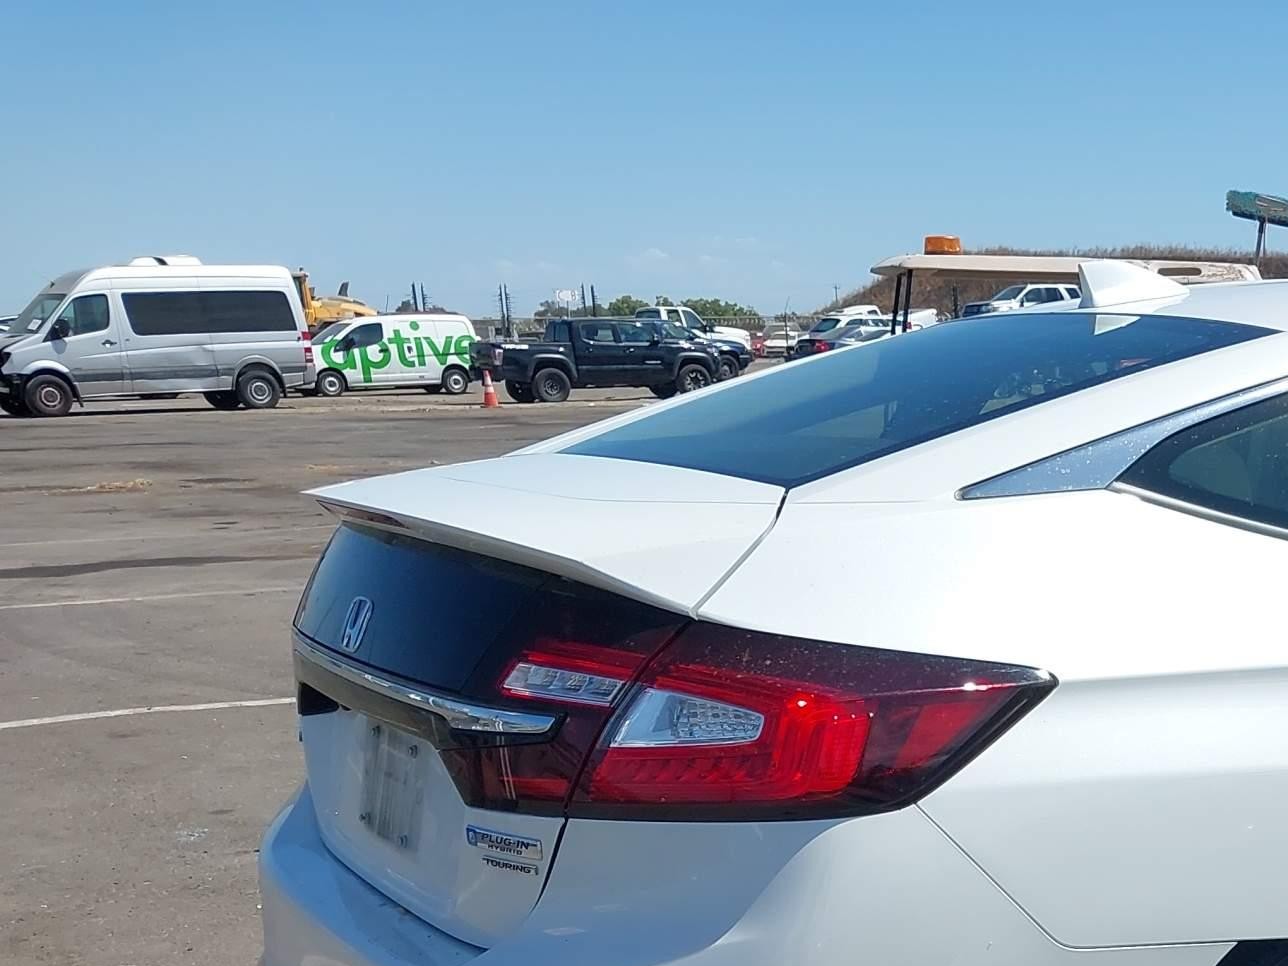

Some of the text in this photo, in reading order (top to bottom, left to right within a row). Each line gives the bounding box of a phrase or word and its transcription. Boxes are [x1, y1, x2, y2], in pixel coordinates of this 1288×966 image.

[321, 321, 476, 383] aptive
[481, 833, 530, 850] PLUG-IN
[487, 844, 523, 856] HYBRID
[485, 858, 531, 873] TOURING
